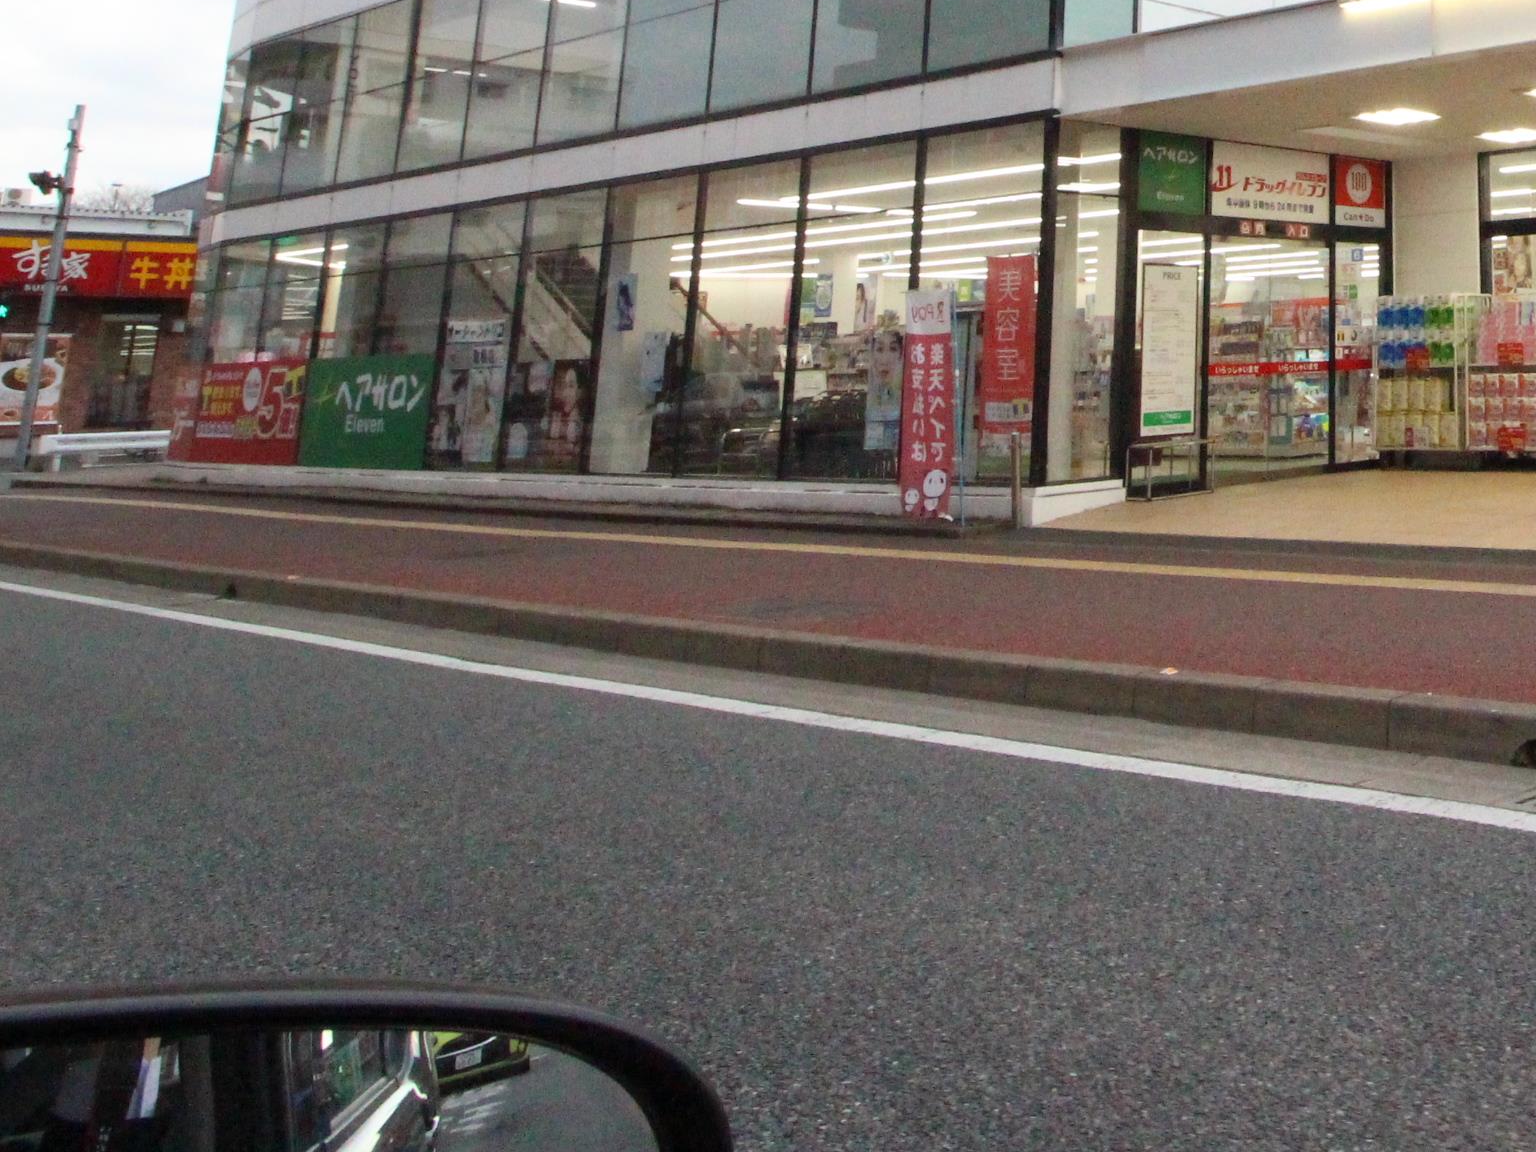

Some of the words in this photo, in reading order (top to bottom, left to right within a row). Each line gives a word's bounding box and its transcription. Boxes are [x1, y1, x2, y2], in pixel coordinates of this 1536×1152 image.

[1143, 147, 1199, 164] ヘアサロン
[1242, 175, 1326, 198] ドラッグイレブン
[1162, 271, 1182, 281] PRICE
[995, 270, 1023, 381] 美容室
[335, 373, 426, 413] ヘアサロン
[344, 414, 385, 434] Eleven
